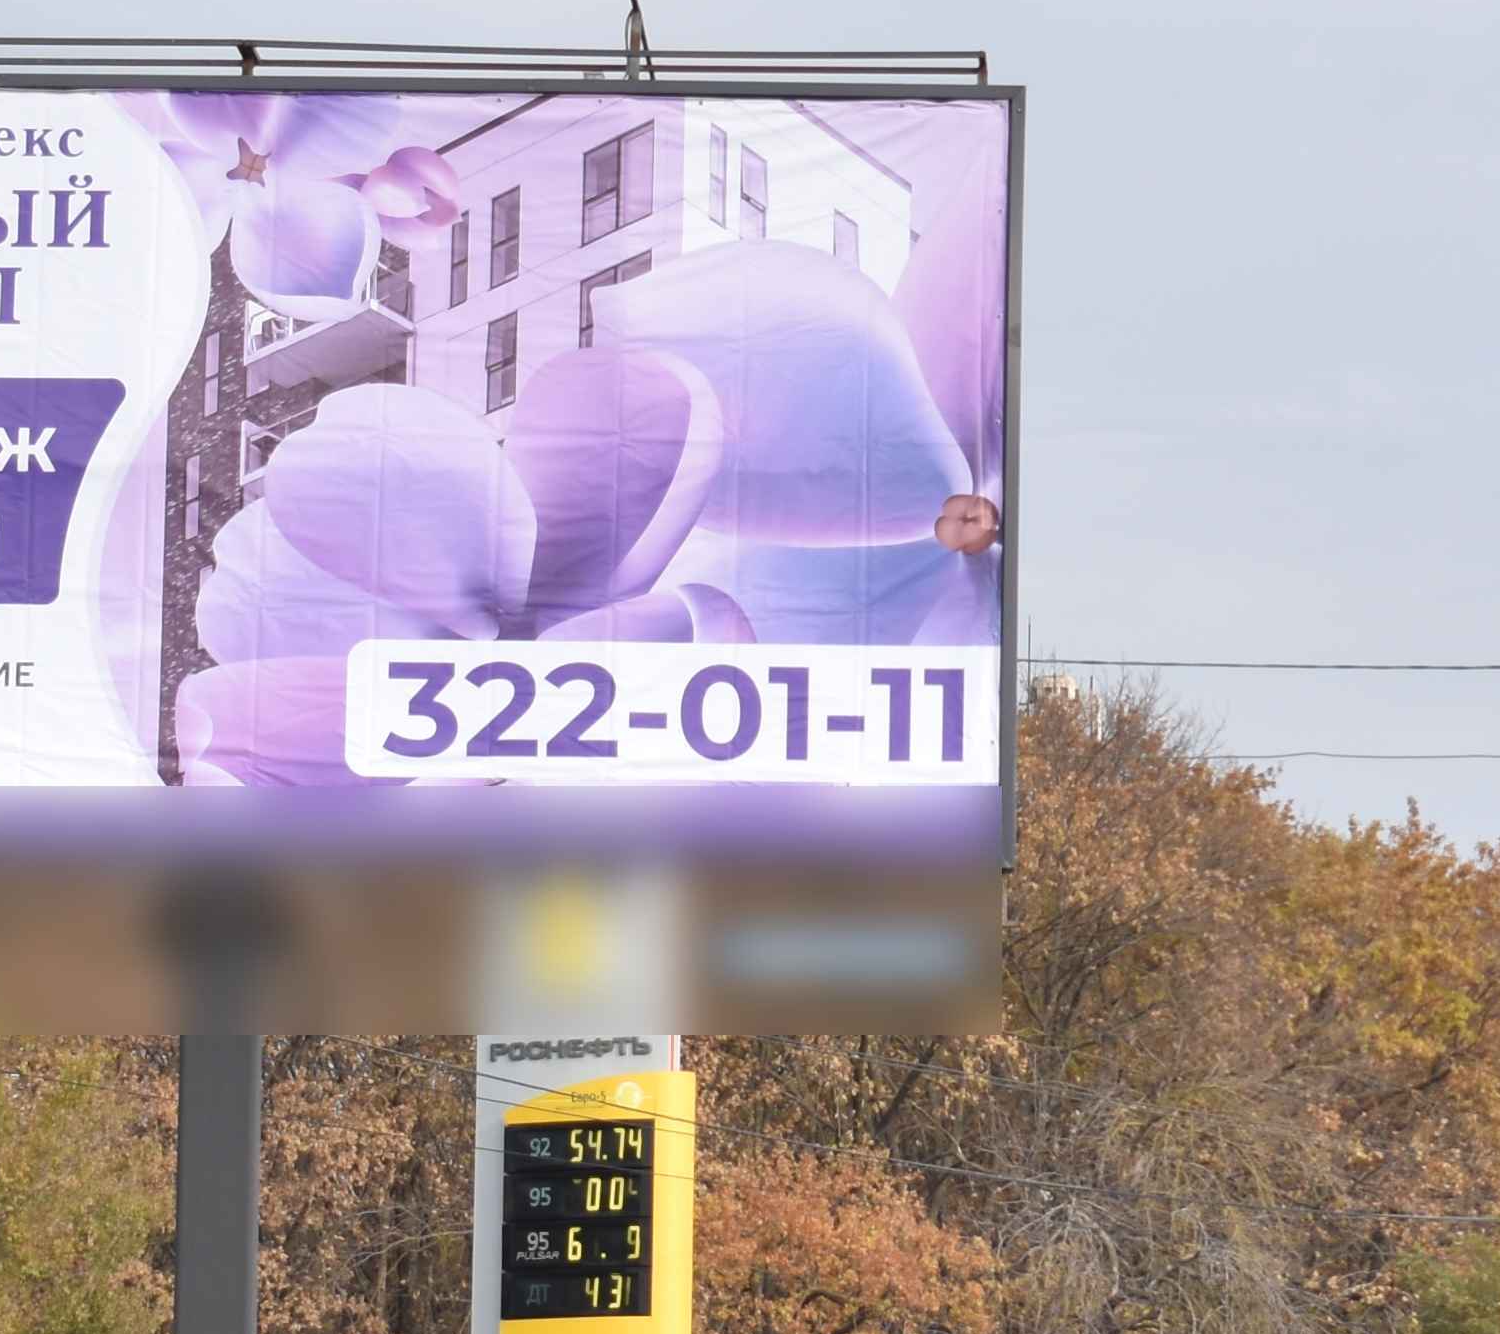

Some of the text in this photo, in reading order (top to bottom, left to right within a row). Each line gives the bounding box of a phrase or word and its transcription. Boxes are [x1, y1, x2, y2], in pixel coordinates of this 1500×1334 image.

[381, 660, 965, 763] 322-01-11
[488, 1035, 653, 1063] РОСНЕФТЬ
[529, 1127, 643, 1163] 92 54.74
[528, 1186, 552, 1208] 95
[526, 1231, 550, 1251] 95
